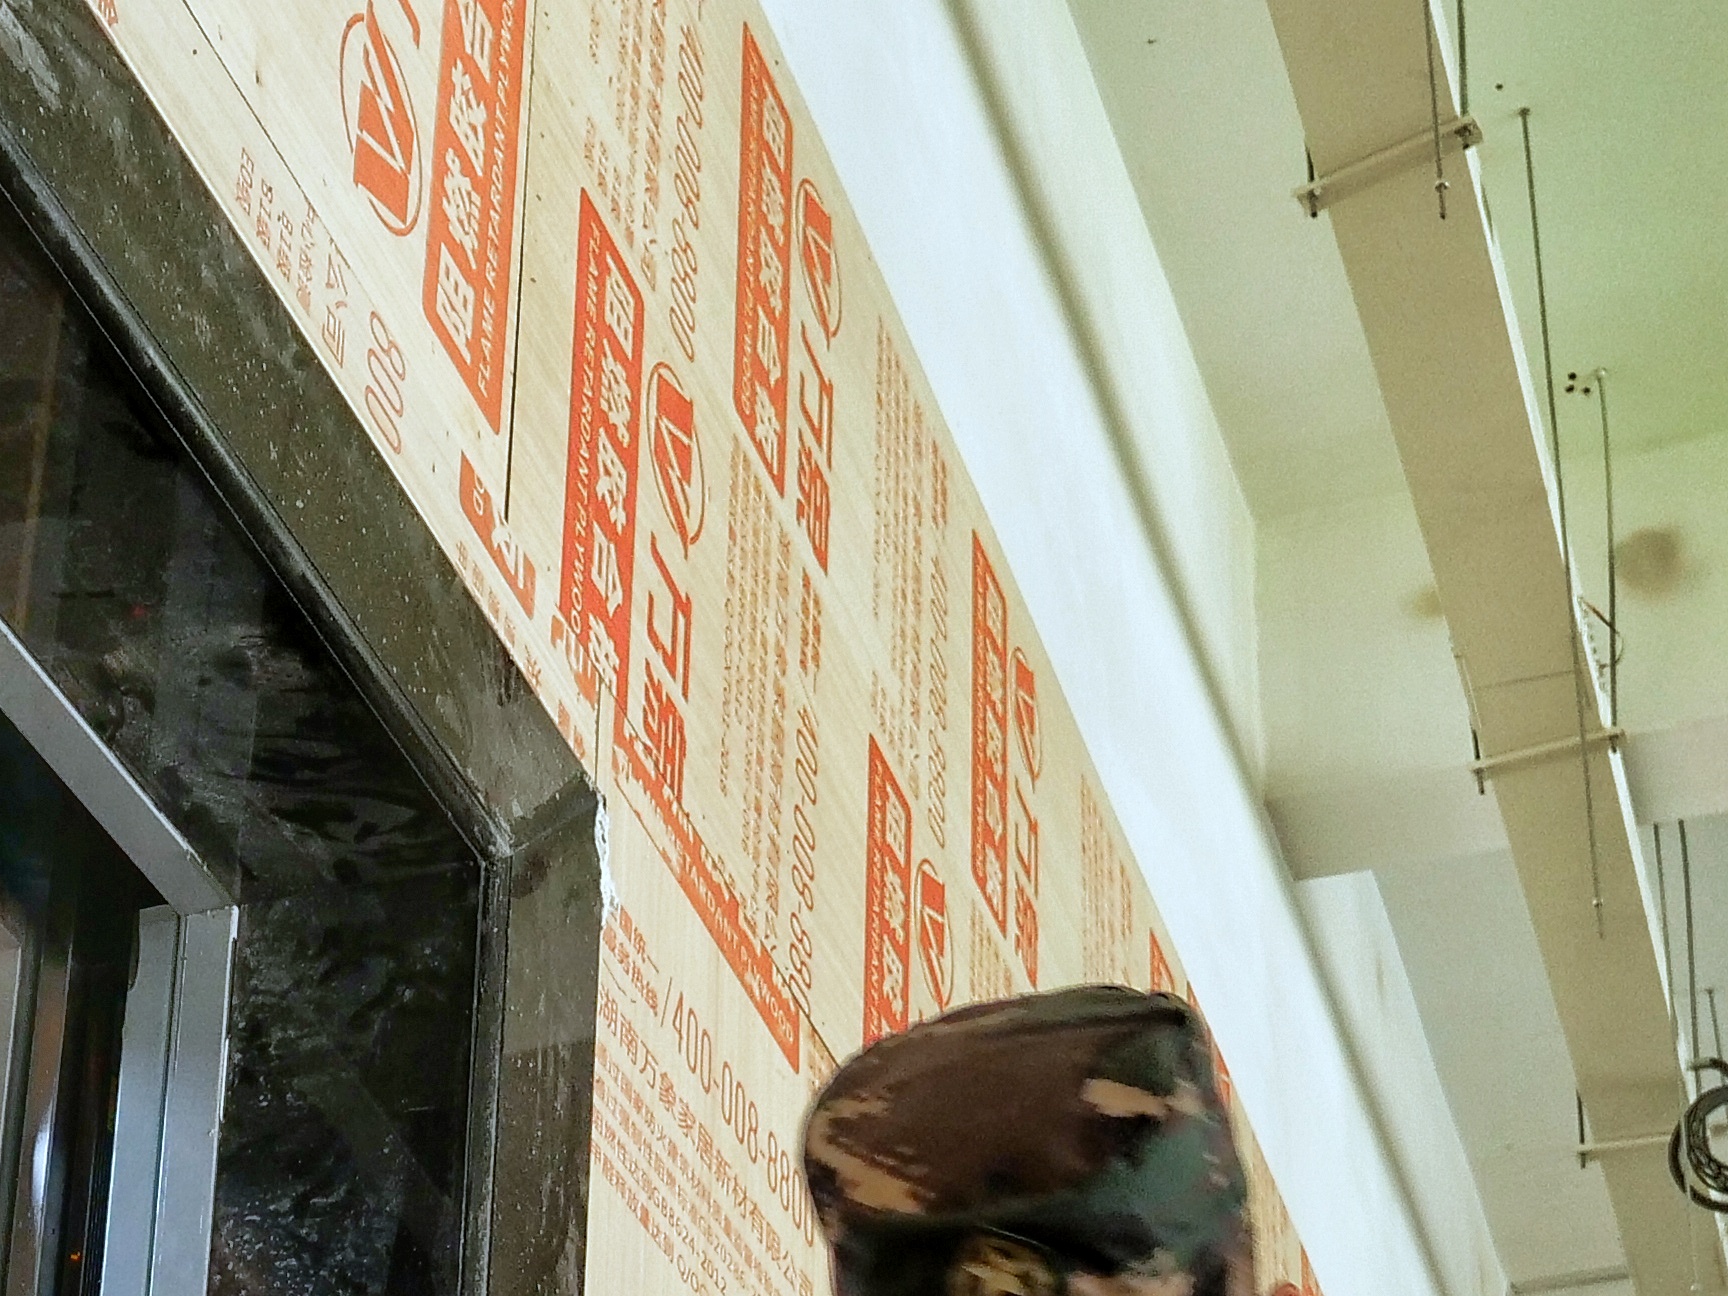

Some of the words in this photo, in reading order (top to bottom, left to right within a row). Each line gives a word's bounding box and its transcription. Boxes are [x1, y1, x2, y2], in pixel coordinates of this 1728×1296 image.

[570, 513, 589, 636] PLYWOO
[881, 779, 907, 1032] 阻燃胶
